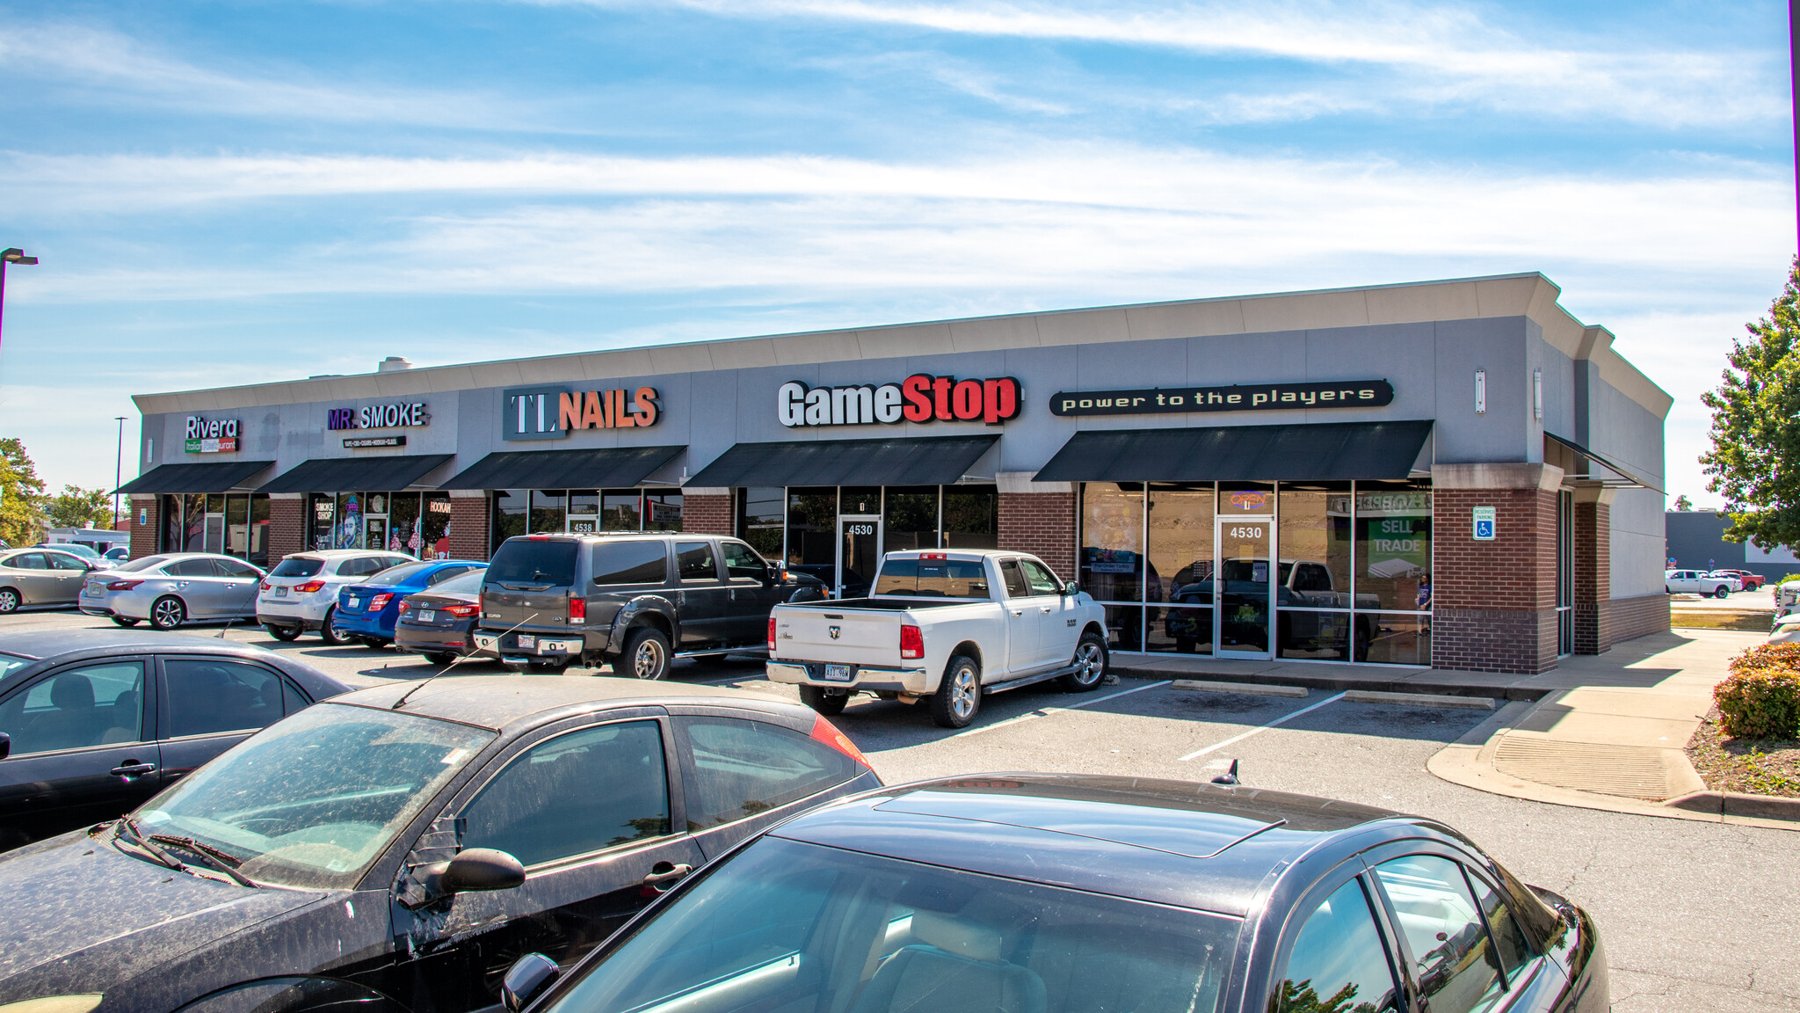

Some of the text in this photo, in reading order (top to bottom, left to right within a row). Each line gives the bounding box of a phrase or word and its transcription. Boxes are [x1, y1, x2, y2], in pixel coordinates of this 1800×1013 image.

[778, 375, 1016, 427] GameStop
[1062, 389, 1375, 412] power to the players
[328, 403, 423, 430] MR. SMOKE
[511, 386, 657, 434] TL NAILS
[186, 416, 238, 439] Rivera
[1231, 493, 1266, 506] OPEN
[429, 501, 452, 514] HOOKAH
[574, 523, 593, 532] 4538
[848, 525, 873, 535] 4530
[1230, 527, 1263, 539] 4530
[1381, 520, 1413, 533] SELL
[1374, 538, 1421, 552] TRADE
